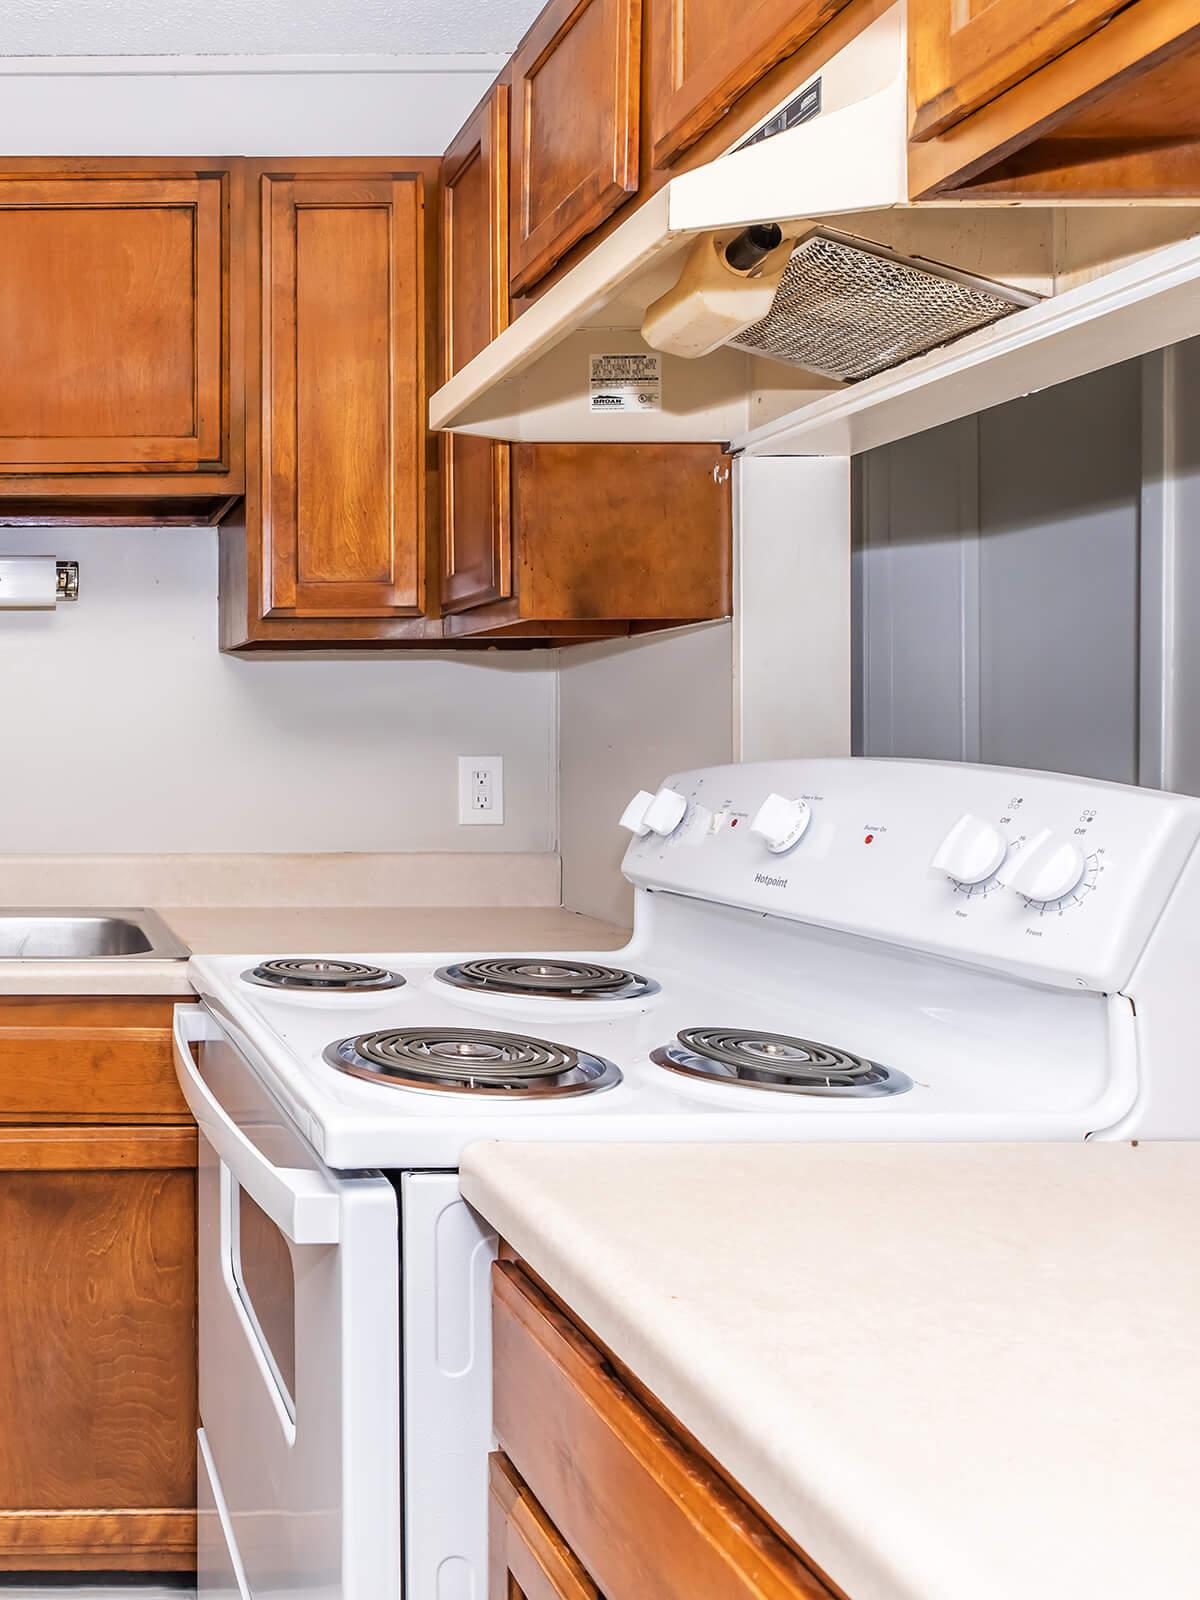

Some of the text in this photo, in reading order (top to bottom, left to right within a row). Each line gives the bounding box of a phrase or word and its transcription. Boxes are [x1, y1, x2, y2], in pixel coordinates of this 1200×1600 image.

[1074, 827, 1086, 835] Off
[754, 872, 788, 888] Hotpoint
[1025, 927, 1043, 938] Front
